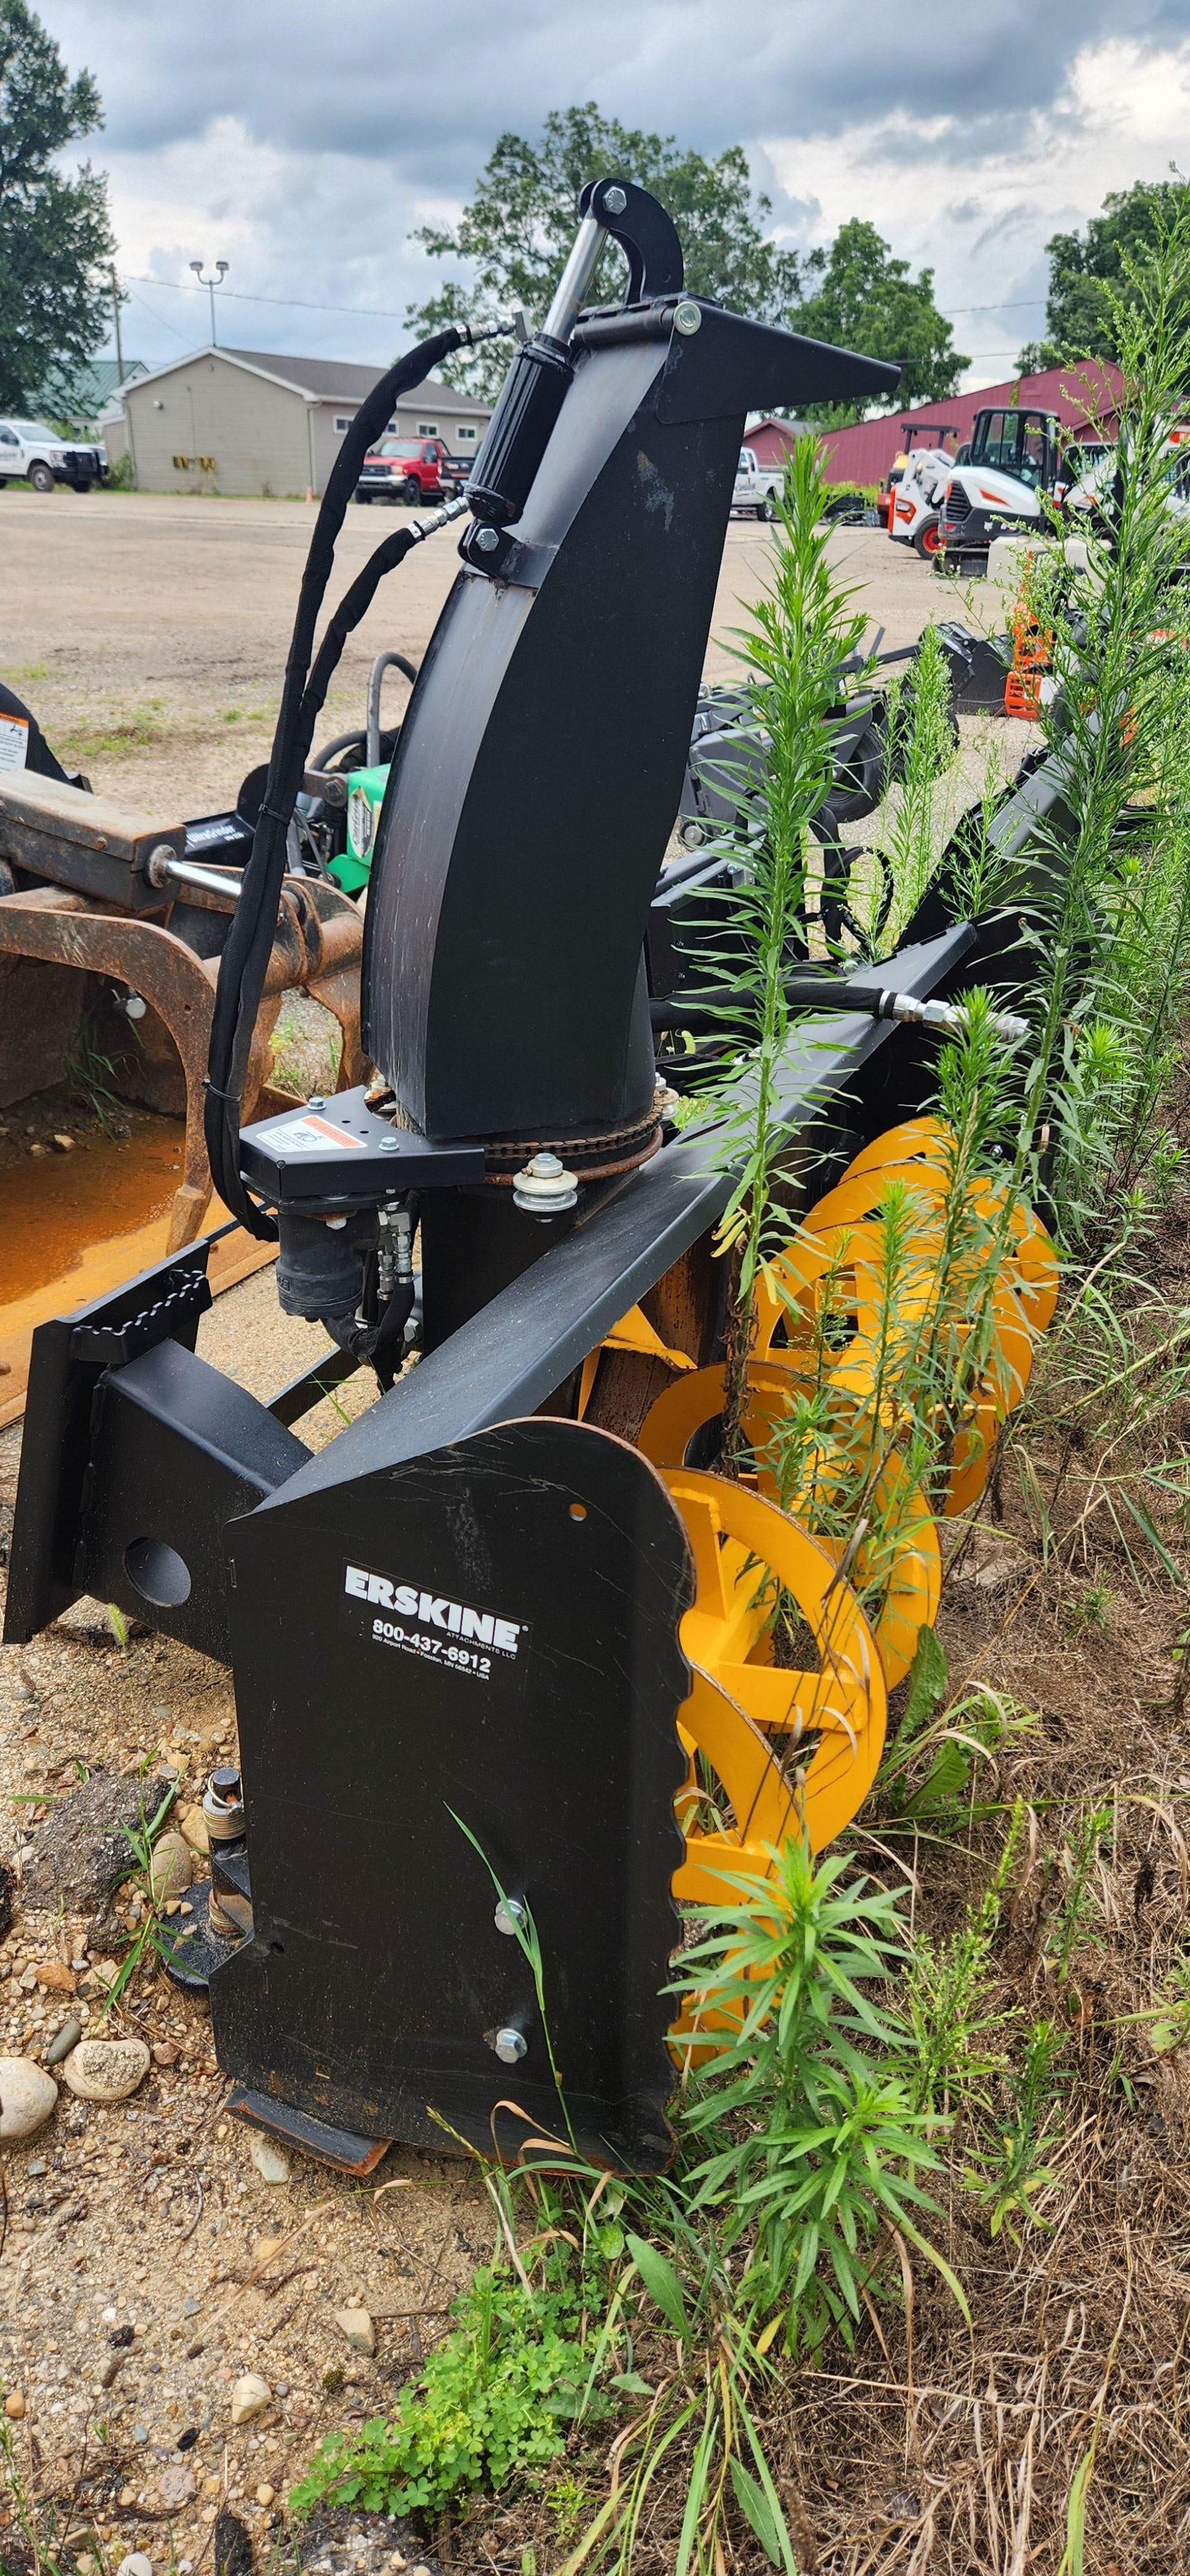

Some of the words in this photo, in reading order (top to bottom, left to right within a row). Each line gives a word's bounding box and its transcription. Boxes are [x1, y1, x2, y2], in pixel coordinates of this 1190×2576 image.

[372, 1619, 491, 1673] 800-437-6912
[383, 1638, 401, 1649] Airport
[401, 1644, 416, 1654] Road
[477, 1671, 489, 1680] USA
[446, 1631, 500, 1654] ATTACHMENTS
[502, 1651, 516, 1660] LLC
